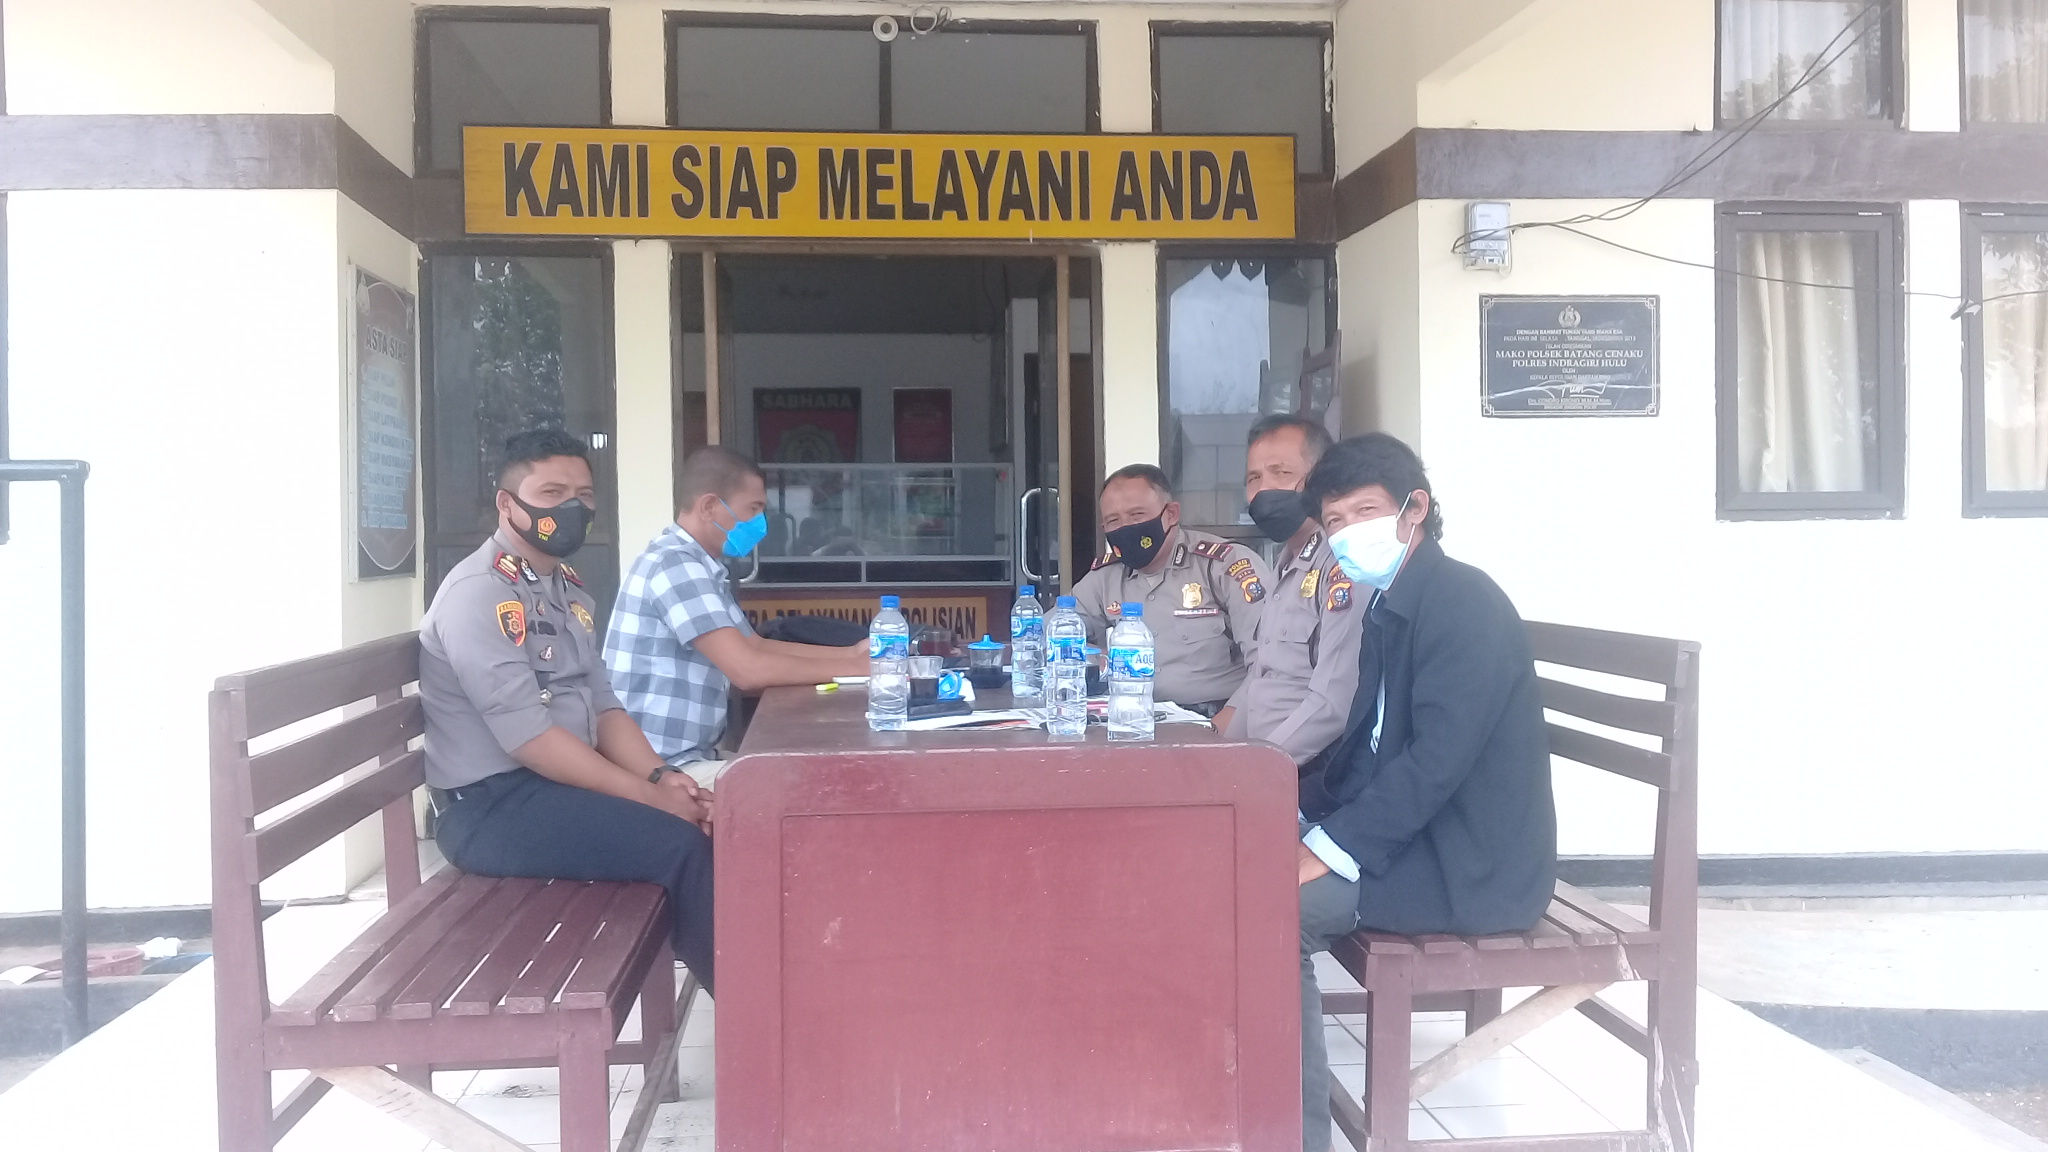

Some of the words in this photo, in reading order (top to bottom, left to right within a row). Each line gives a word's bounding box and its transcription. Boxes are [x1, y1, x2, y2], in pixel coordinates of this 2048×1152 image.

[503, 141, 650, 218] KAMI
[671, 144, 797, 220] SIAP
[818, 147, 1090, 222] MELAYANI
[1109, 150, 1259, 222] ANDA
[365, 325, 388, 356] ASTA
[1495, 350, 1525, 358] MAKO
[1527, 350, 1562, 358] POLSEK
[1564, 350, 1603, 358] BATANG
[1604, 350, 1643, 358] CENAKU
[1512, 359, 1547, 367] POLRES
[1549, 359, 1599, 367] INDRAGIRI
[1601, 359, 1627, 367] HULU
[762, 393, 852, 409] SABHARA
